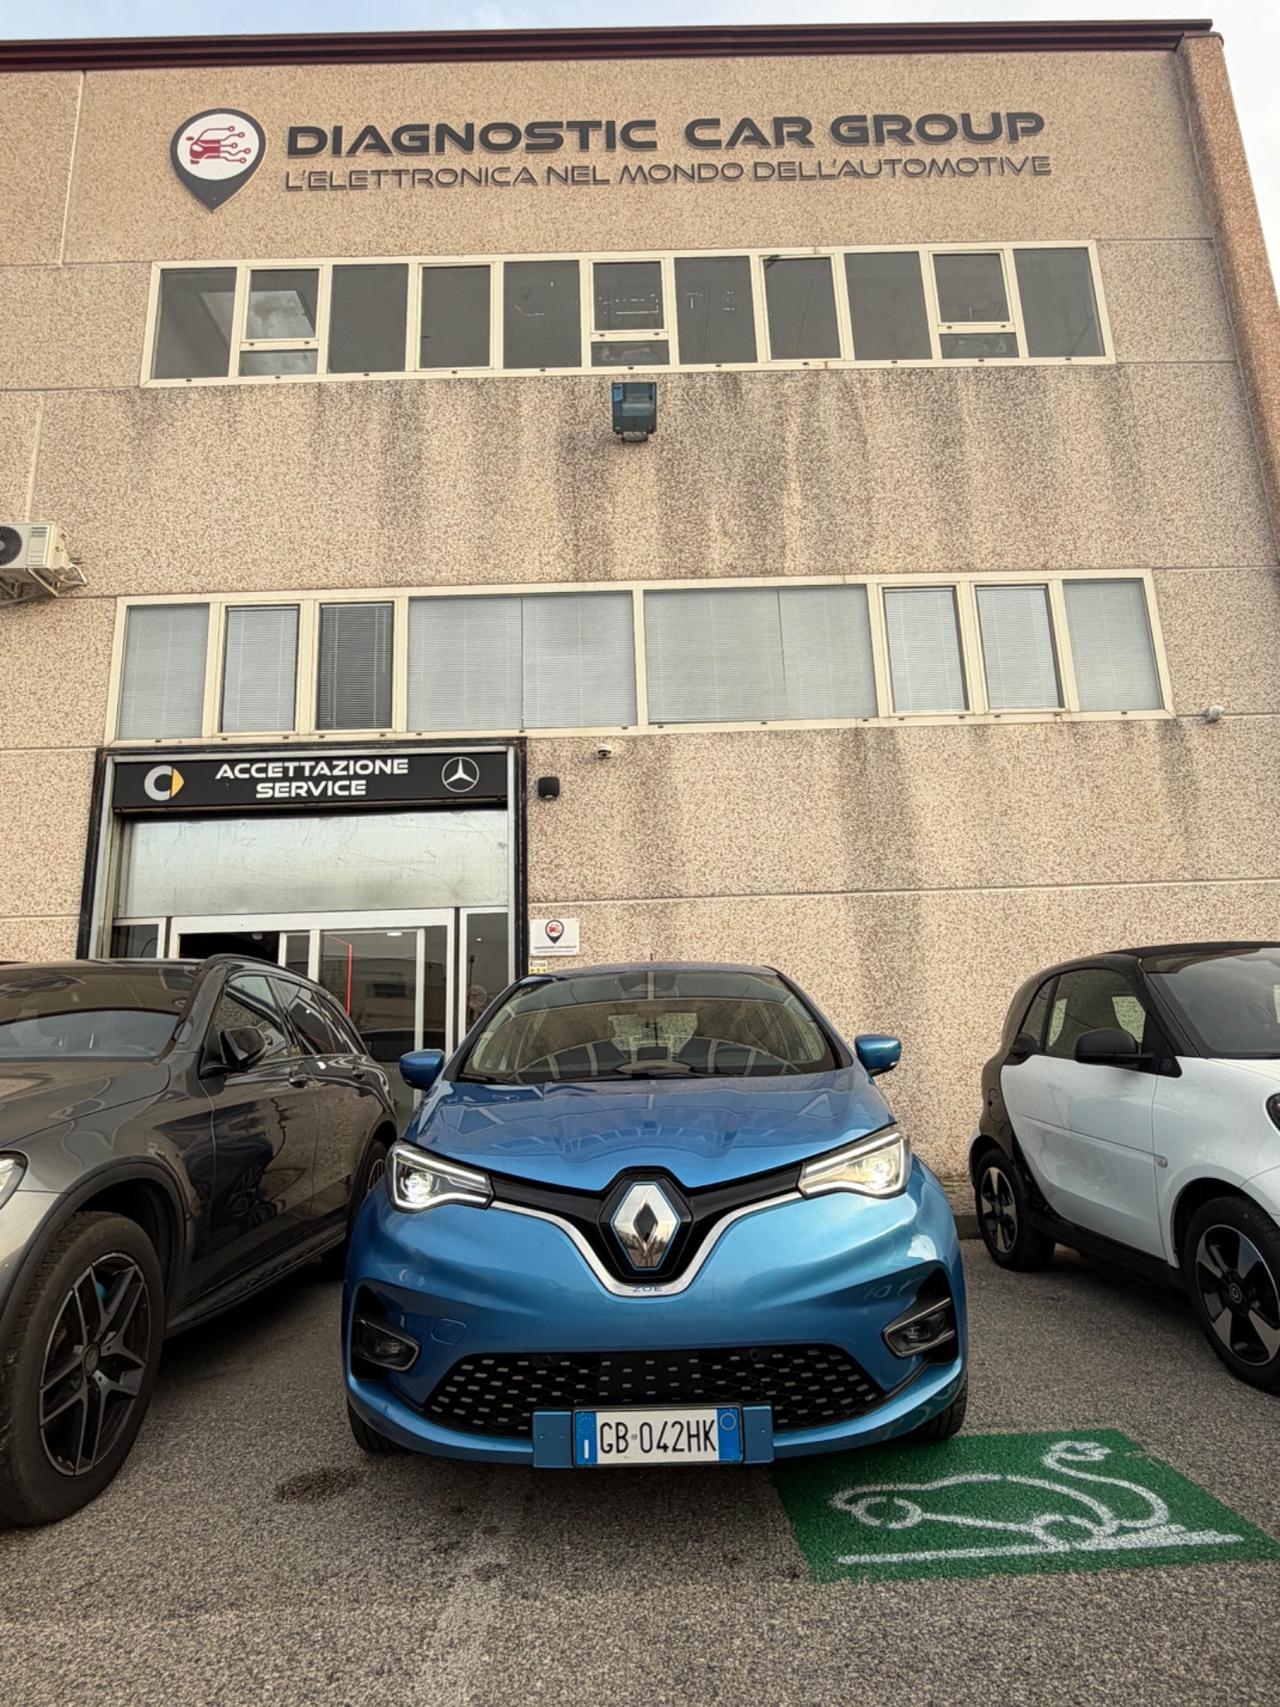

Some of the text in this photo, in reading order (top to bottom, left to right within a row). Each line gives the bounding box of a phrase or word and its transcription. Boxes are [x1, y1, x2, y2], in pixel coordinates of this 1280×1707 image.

[287, 112, 1046, 157] DIAGNOSTIC CAR GROUP
[285, 156, 1053, 192] L'ELETTRONICA NEL MONDO DELL'AUTOMOTIVE
[215, 758, 410, 780] ACCETTAZIONE
[255, 780, 368, 799] SERVICE
